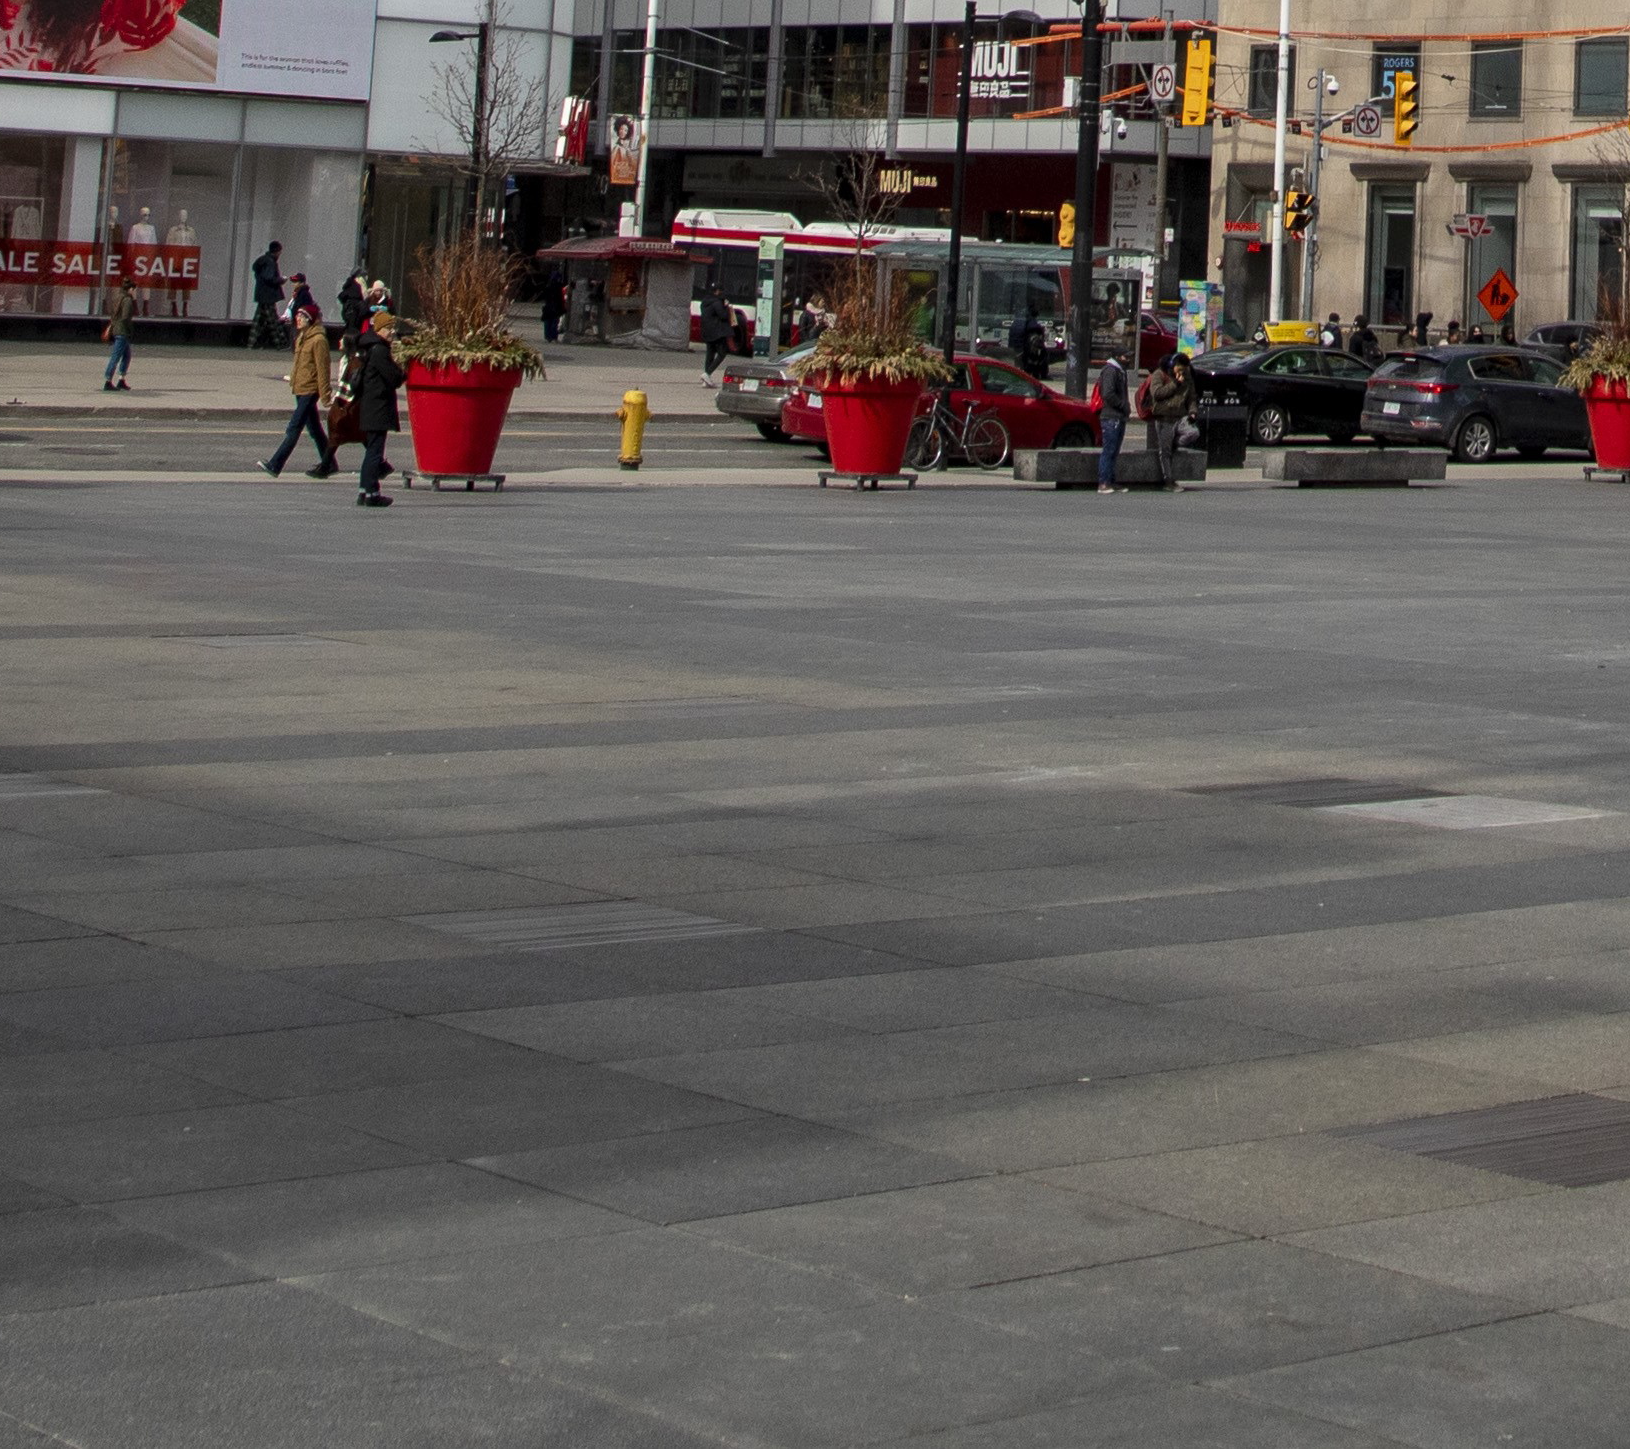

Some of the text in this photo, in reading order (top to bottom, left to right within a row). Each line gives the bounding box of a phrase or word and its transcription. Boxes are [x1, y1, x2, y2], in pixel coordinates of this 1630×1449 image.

[972, 40, 1018, 78] MUJI
[1383, 57, 1415, 68] ROGERS
[879, 169, 912, 194] MUJI
[52, 251, 123, 278] SALE
[133, 254, 199, 281] SALE
